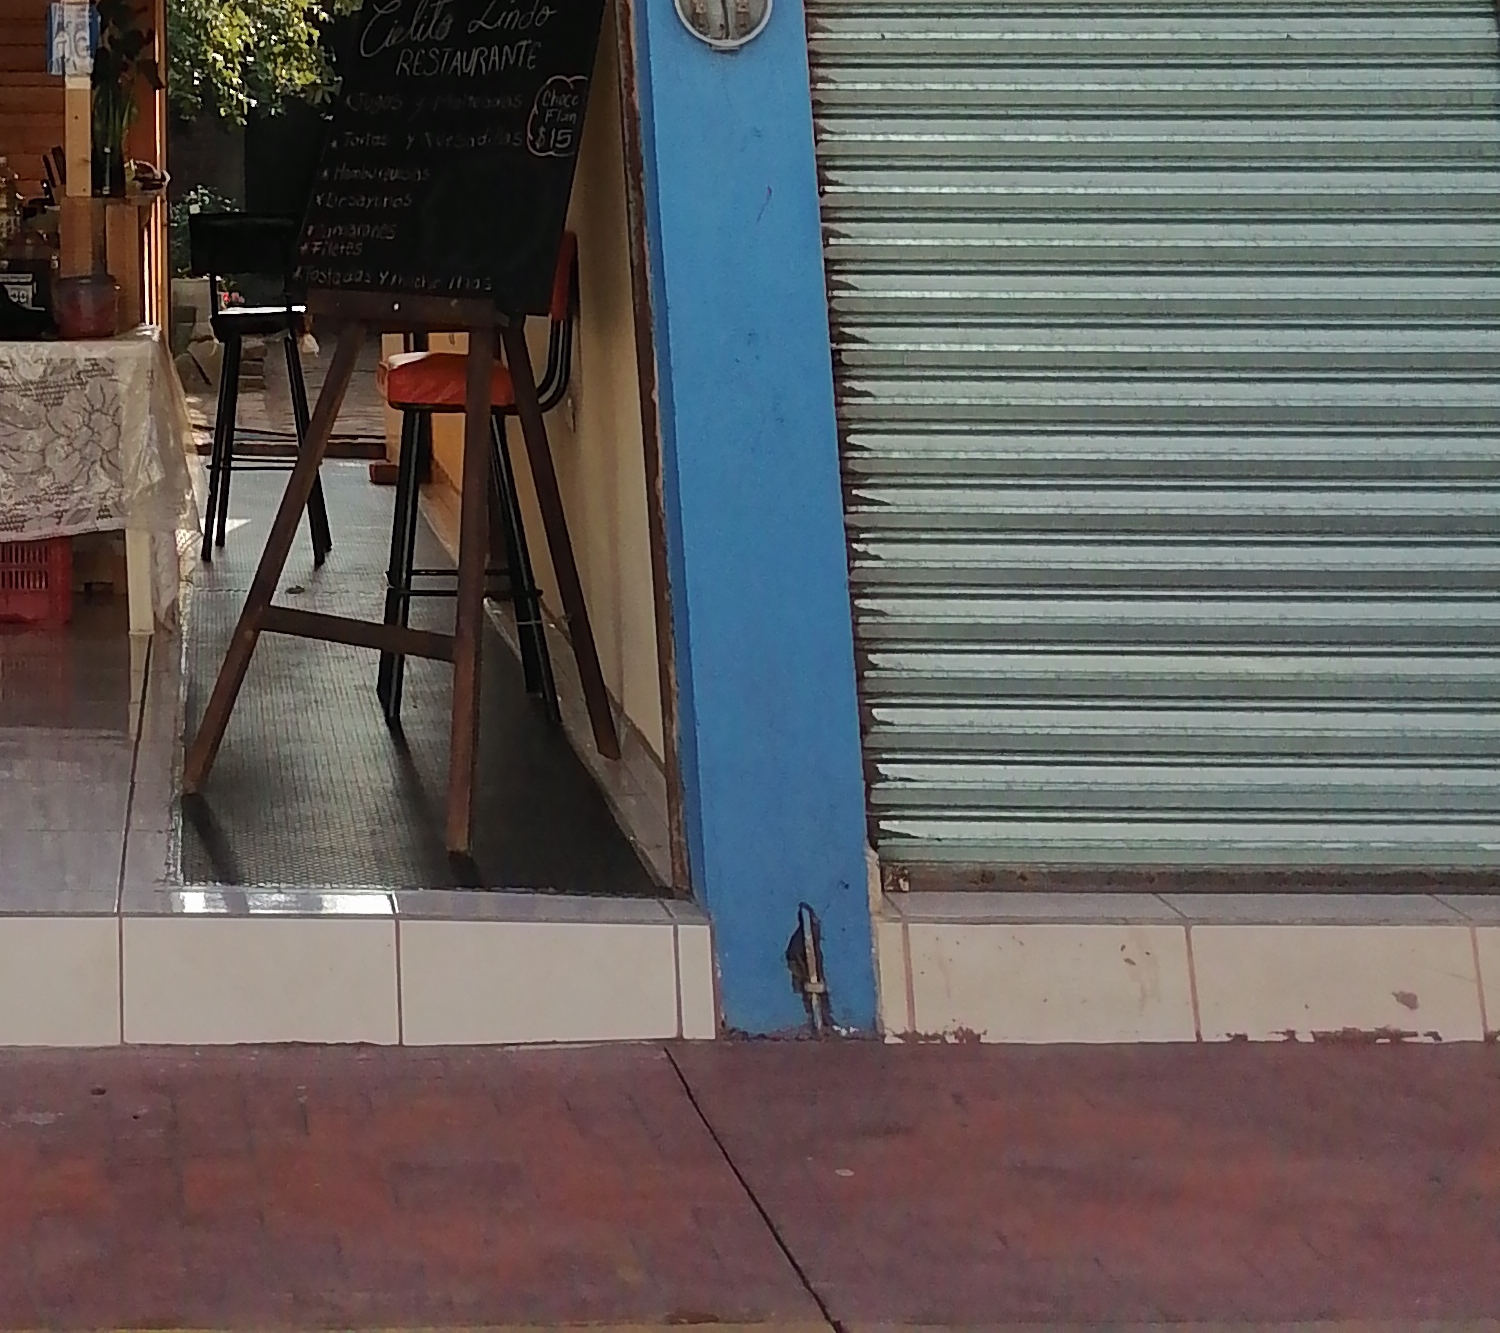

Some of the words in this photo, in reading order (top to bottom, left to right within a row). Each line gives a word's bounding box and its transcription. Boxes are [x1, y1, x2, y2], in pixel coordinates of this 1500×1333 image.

[395, 38, 542, 77] RESTAURANTE
[544, 108, 577, 125] Flan
[535, 125, 574, 149] $15
